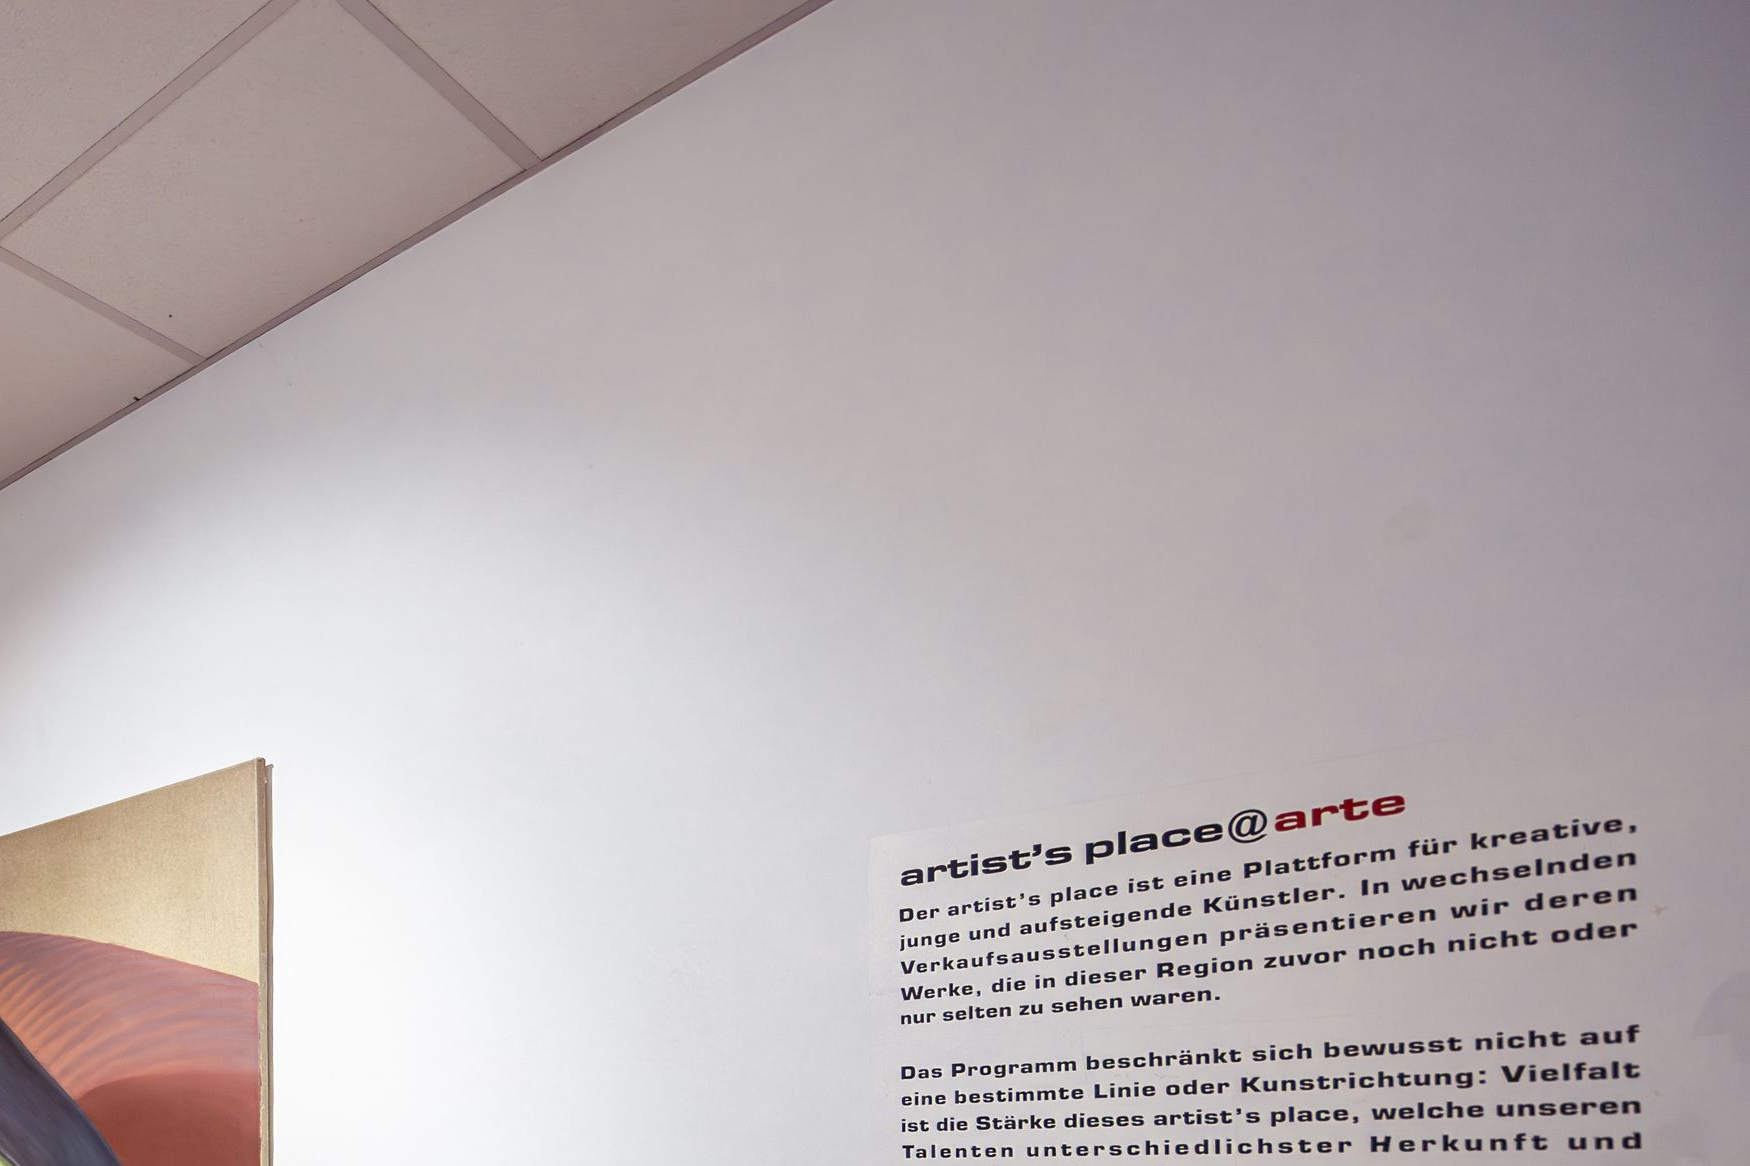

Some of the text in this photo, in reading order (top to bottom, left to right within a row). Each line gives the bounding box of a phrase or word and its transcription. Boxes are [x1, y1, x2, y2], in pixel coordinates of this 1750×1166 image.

[898, 818, 1637, 923] Der artist's place ist eine Plattform für kreative,
[900, 794, 1406, 887] artist's place@arte
[899, 852, 1637, 952] junge und aufsteigende Künstler. In wechselnden
[900, 887, 1638, 975] Verkaufsausstellungen präsentieren wir deren
[900, 922, 1638, 1002] Werke, die in dieser Region zuvor noch nicht oder
[900, 989, 1221, 1026] nur selten zu sehen waren.
[900, 1023, 1640, 1081] Das Programm beschränkt sich bewusst nicht auf
[901, 1060, 1641, 1107] eine bestimmte Linie oder Kunstrichtung: Vielfalt
[901, 1100, 1642, 1133] ist die Stärke dieses artist's place, welche unseren
[901, 1131, 1642, 1159] Talenten unterschiedlichster Herkunft und
